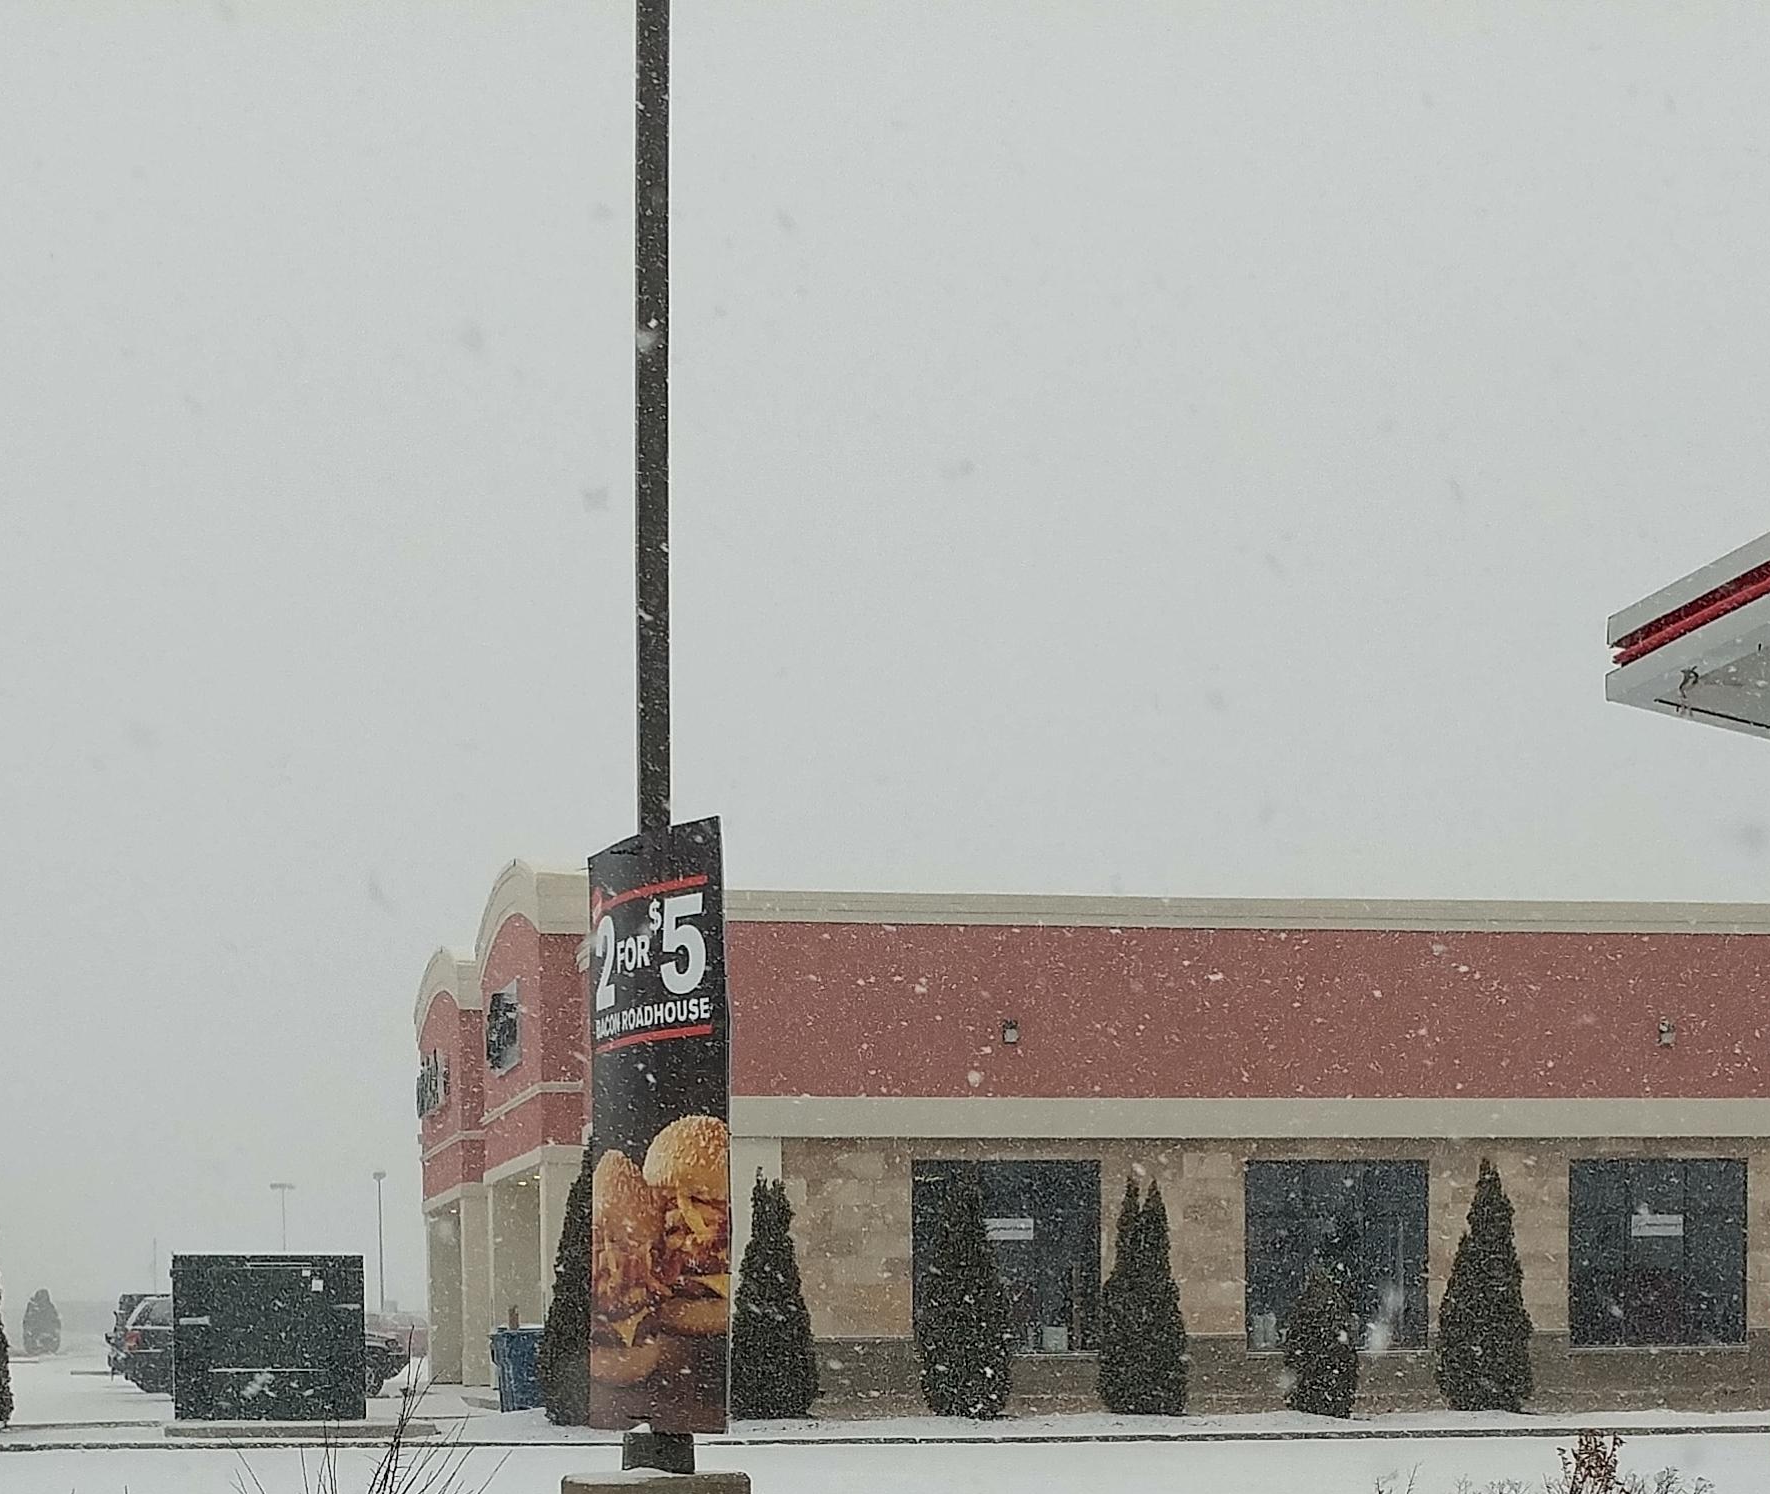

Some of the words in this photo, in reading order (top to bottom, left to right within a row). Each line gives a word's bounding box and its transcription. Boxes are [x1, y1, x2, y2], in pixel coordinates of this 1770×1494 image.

[595, 914, 616, 1012] 2
[616, 934, 651, 974] FOR
[647, 891, 707, 995] $5
[621, 996, 711, 1031] ROADHOUSE
